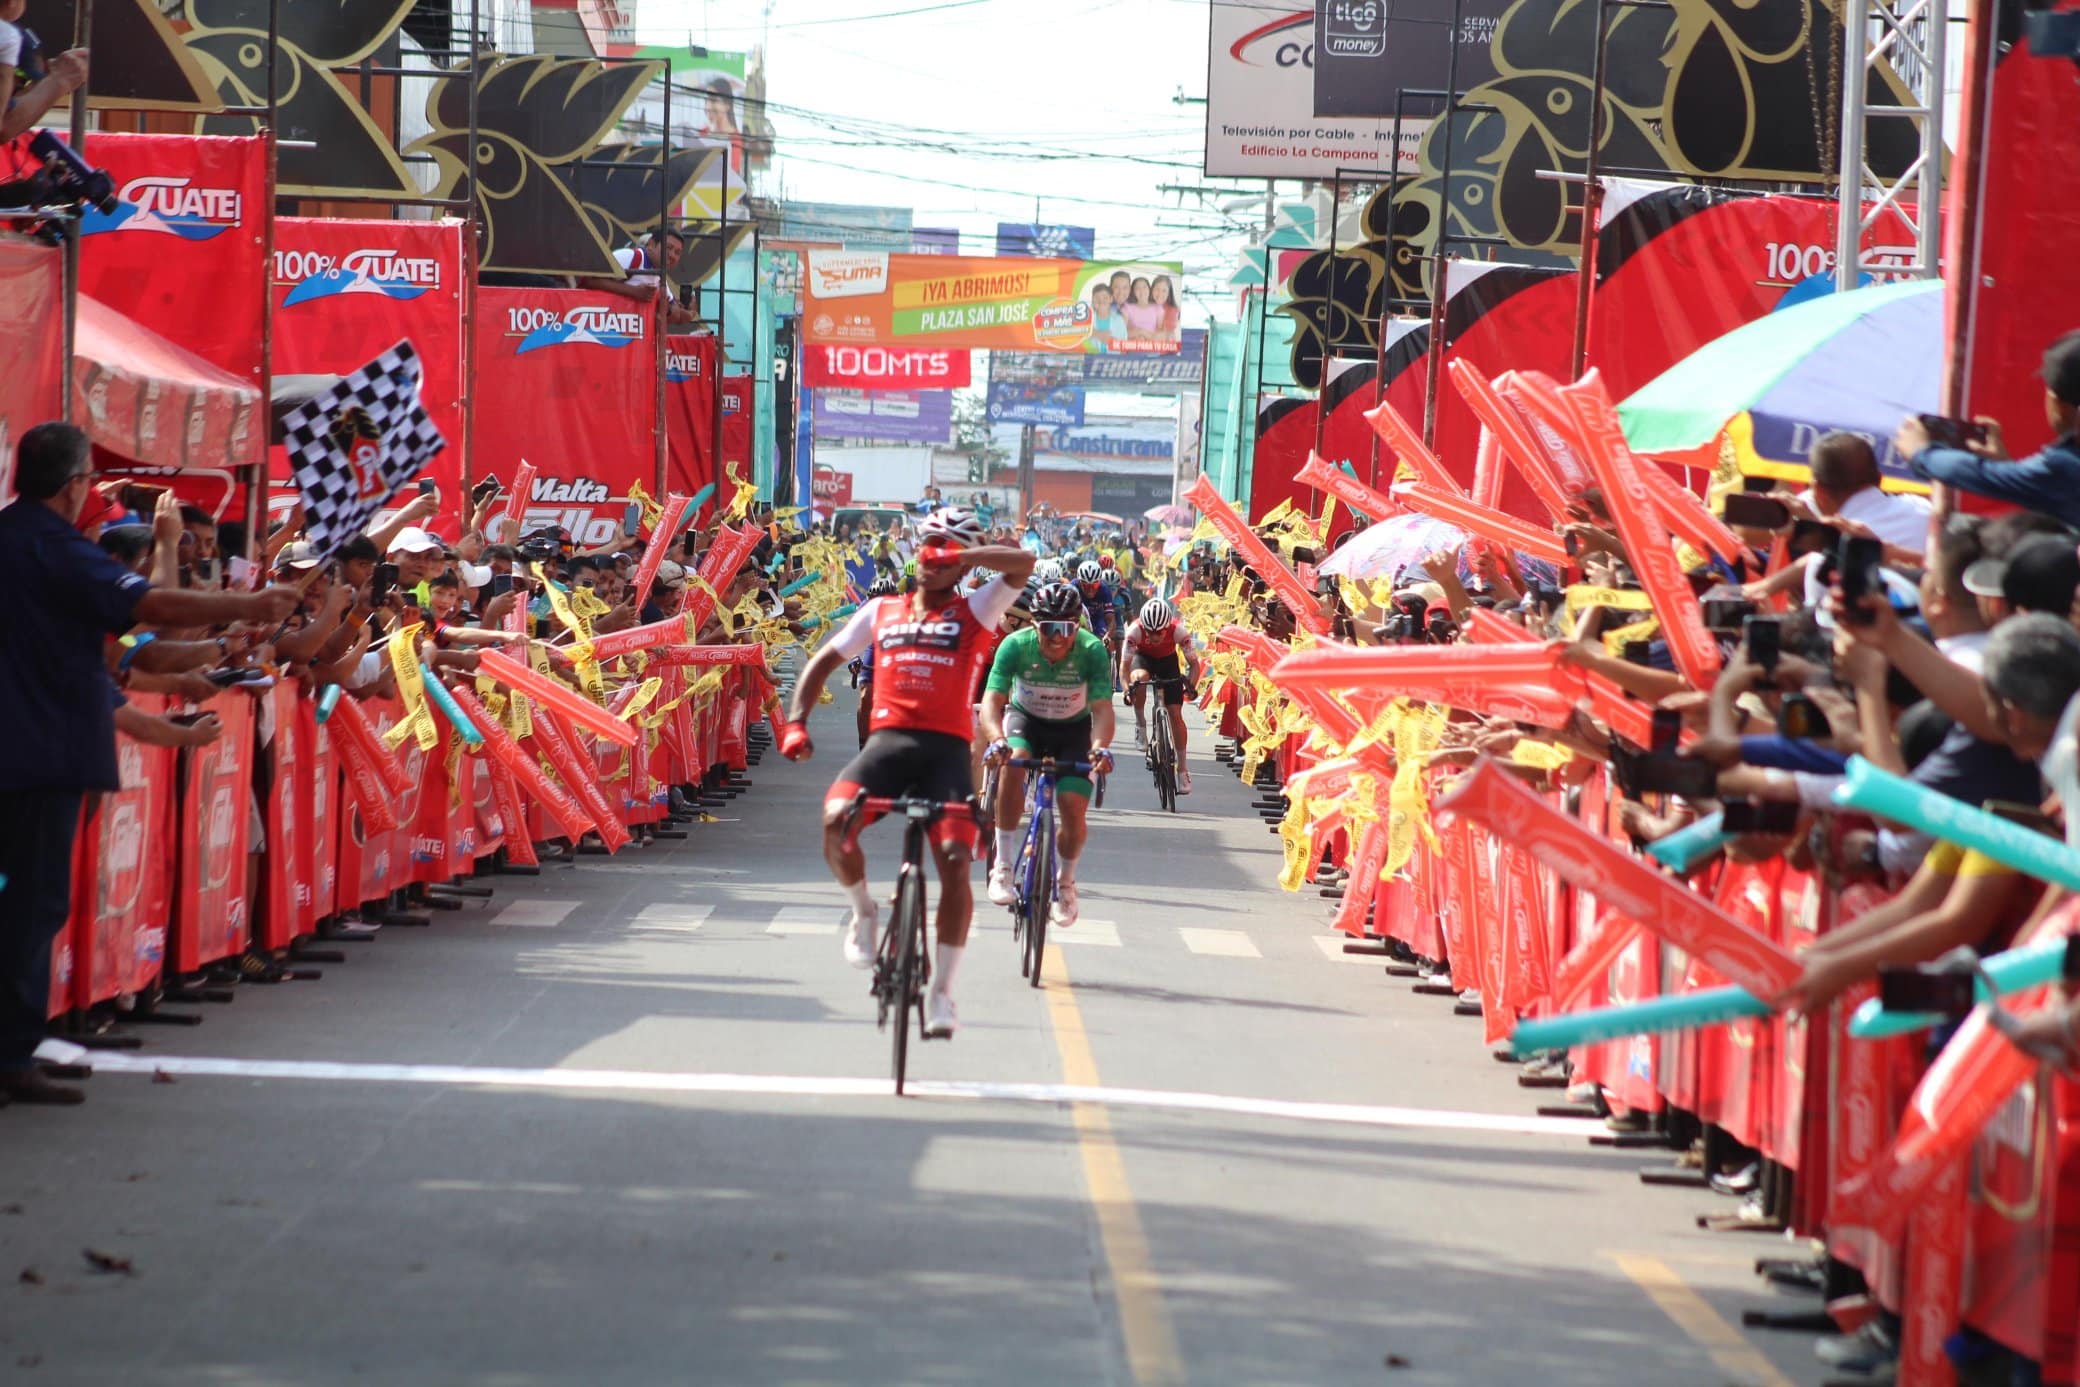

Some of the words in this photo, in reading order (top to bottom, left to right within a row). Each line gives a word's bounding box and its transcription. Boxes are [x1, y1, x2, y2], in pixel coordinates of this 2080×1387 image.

[1336, 2, 1377, 31] tigo
[1333, 38, 1378, 55] money
[1222, 125, 1285, 139] Televisión
[1289, 129, 1311, 141] por
[1315, 128, 1355, 140] Cable
[1241, 144, 1288, 157] Edificio
[1292, 146, 1308, 158] La
[1311, 147, 1378, 161] Campana
[118, 176, 241, 228] GUATE!
[274, 251, 340, 280] 100%
[341, 249, 440, 289] GUATE!
[922, 276, 948, 303] ¡YA
[951, 273, 1030, 299] ABRIMOS!
[508, 307, 562, 332] 100%
[564, 306, 644, 339] GUATE!
[921, 308, 964, 331] PLAZA
[967, 306, 995, 326] SAN
[997, 299, 1029, 322] JOSÉ
[1075, 303, 1088, 320] 3
[825, 346, 949, 376] 100MTS
[1054, 428, 1174, 458] Construrama
[878, 623, 960, 640] HINO
[895, 652, 954, 666] SUZUKI
